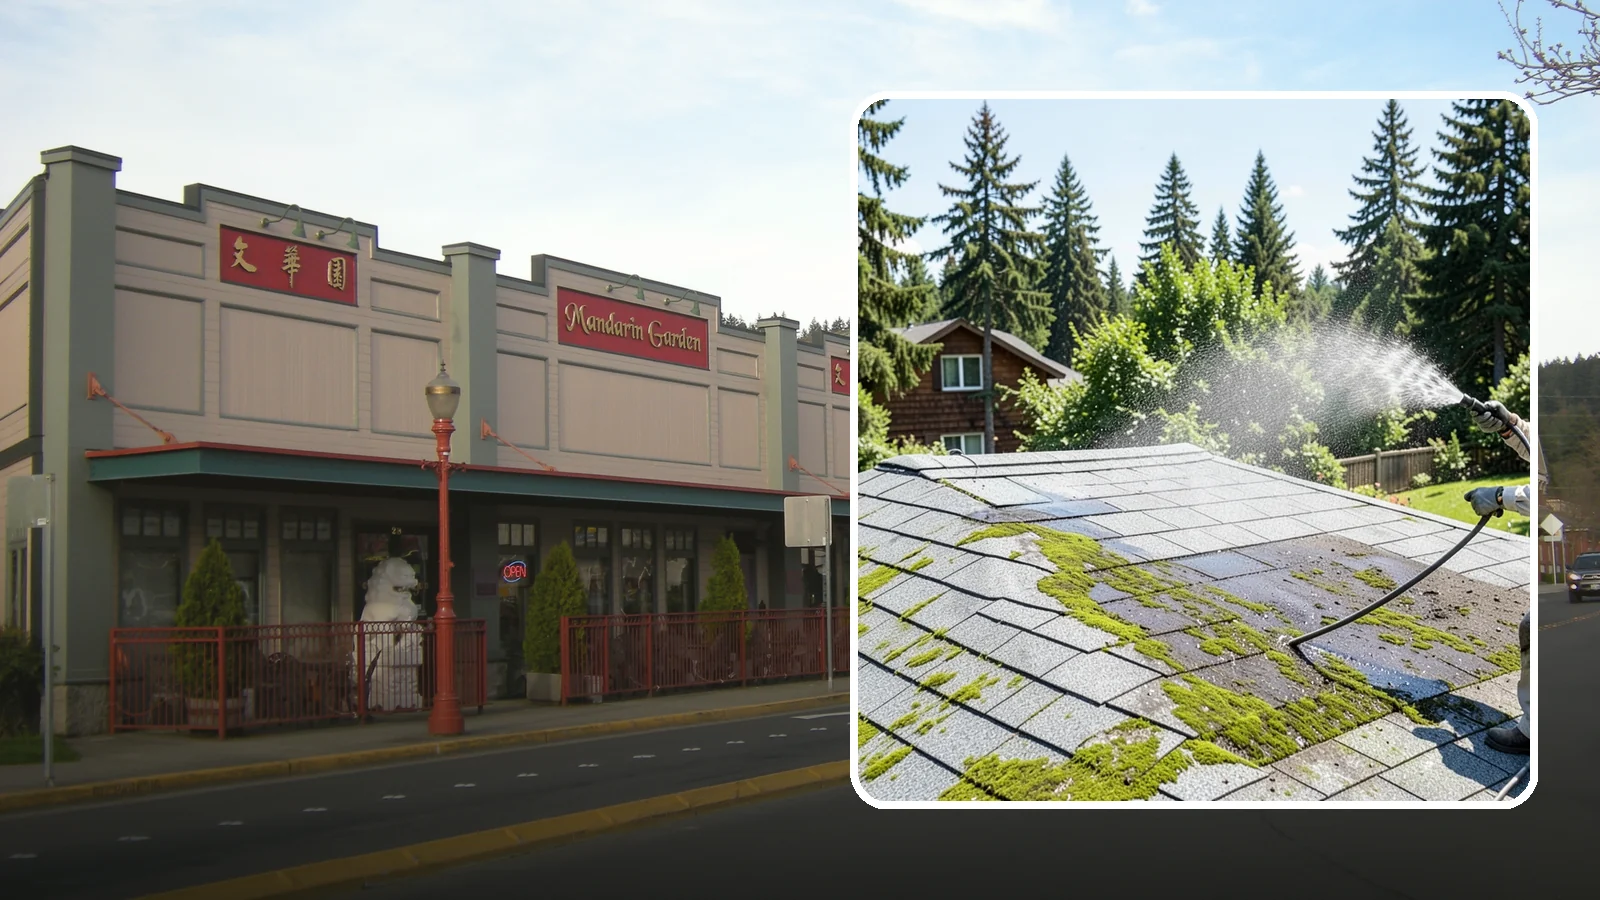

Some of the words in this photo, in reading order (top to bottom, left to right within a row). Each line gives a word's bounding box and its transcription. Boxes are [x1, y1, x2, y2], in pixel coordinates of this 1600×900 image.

[231, 235, 346, 291] 文華園
[564, 302, 644, 341] Mandarin
[648, 320, 702, 352] Garden
[503, 565, 527, 578] OPEN
